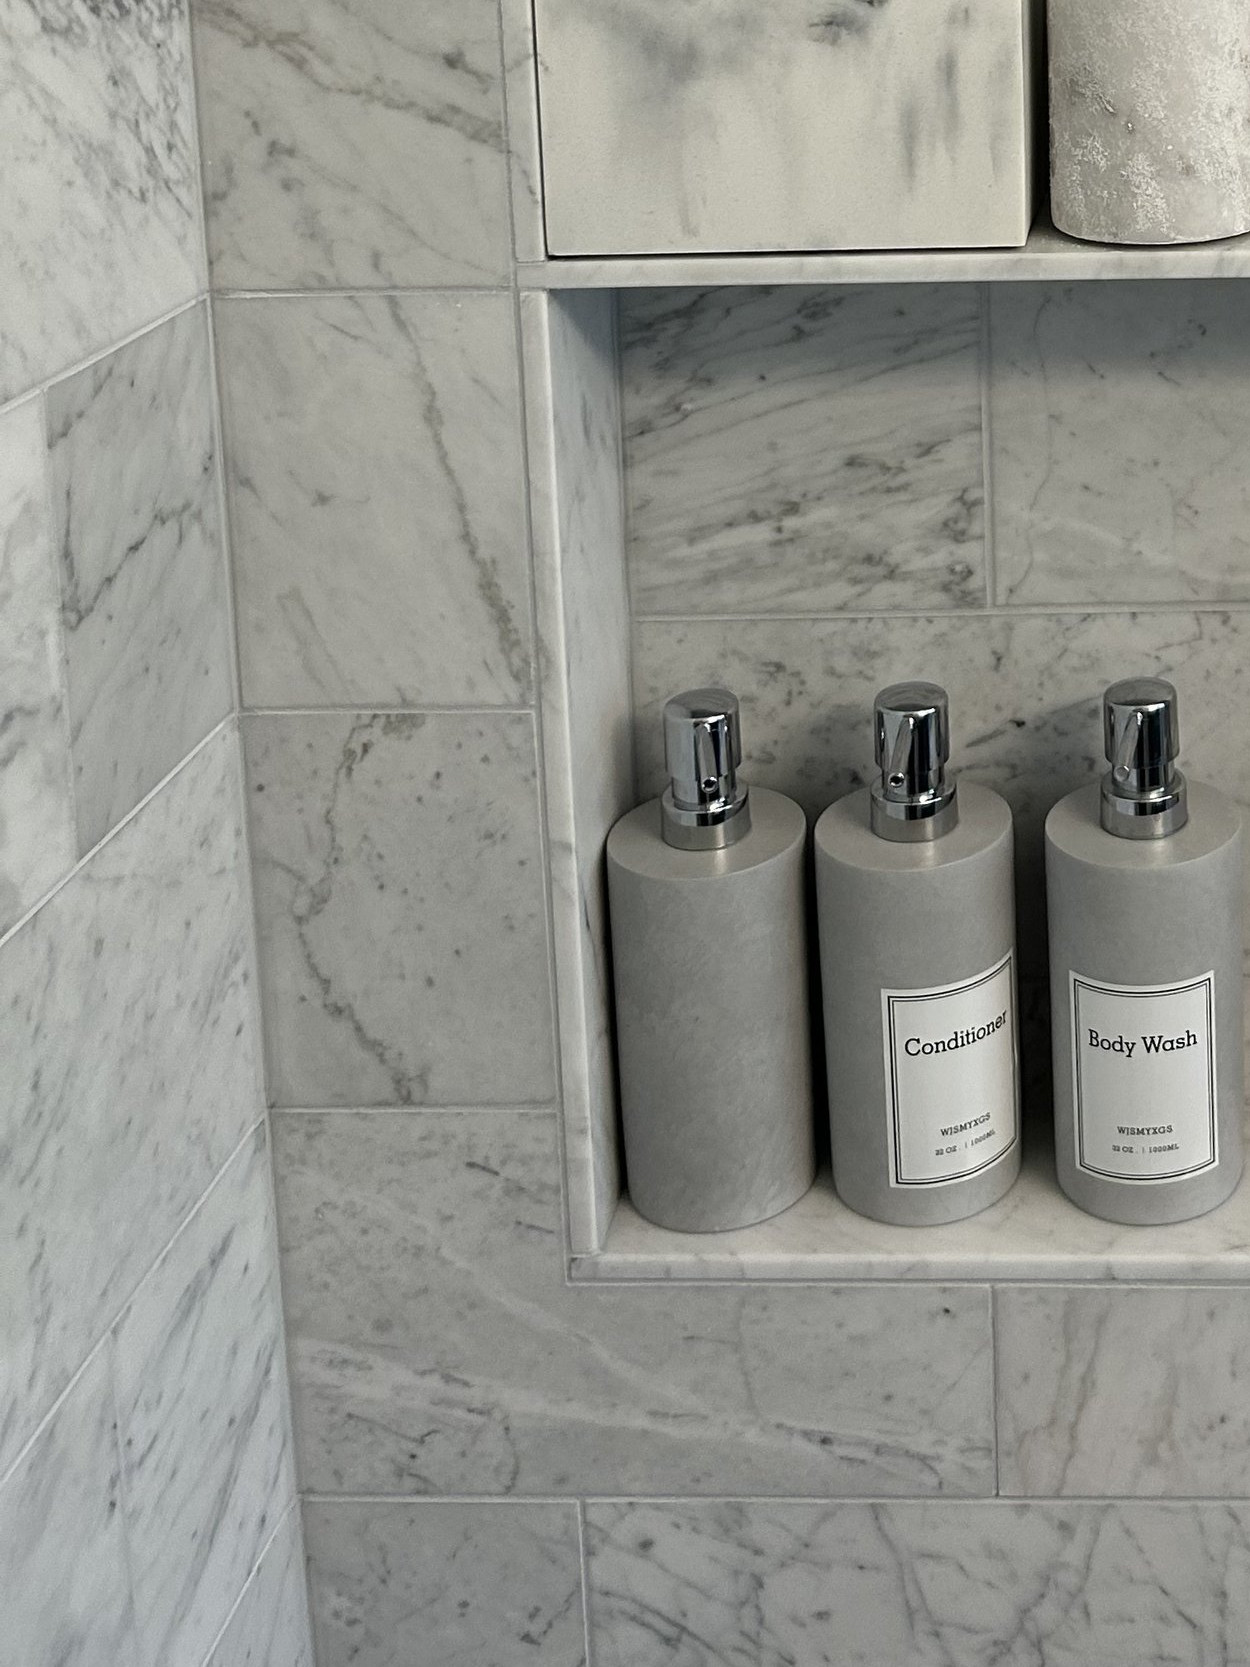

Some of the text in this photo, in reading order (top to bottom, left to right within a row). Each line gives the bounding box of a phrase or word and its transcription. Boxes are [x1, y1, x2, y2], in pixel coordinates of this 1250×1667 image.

[904, 1009, 1008, 1057] Conditioner
[1088, 1028, 1198, 1058] Body Wash
